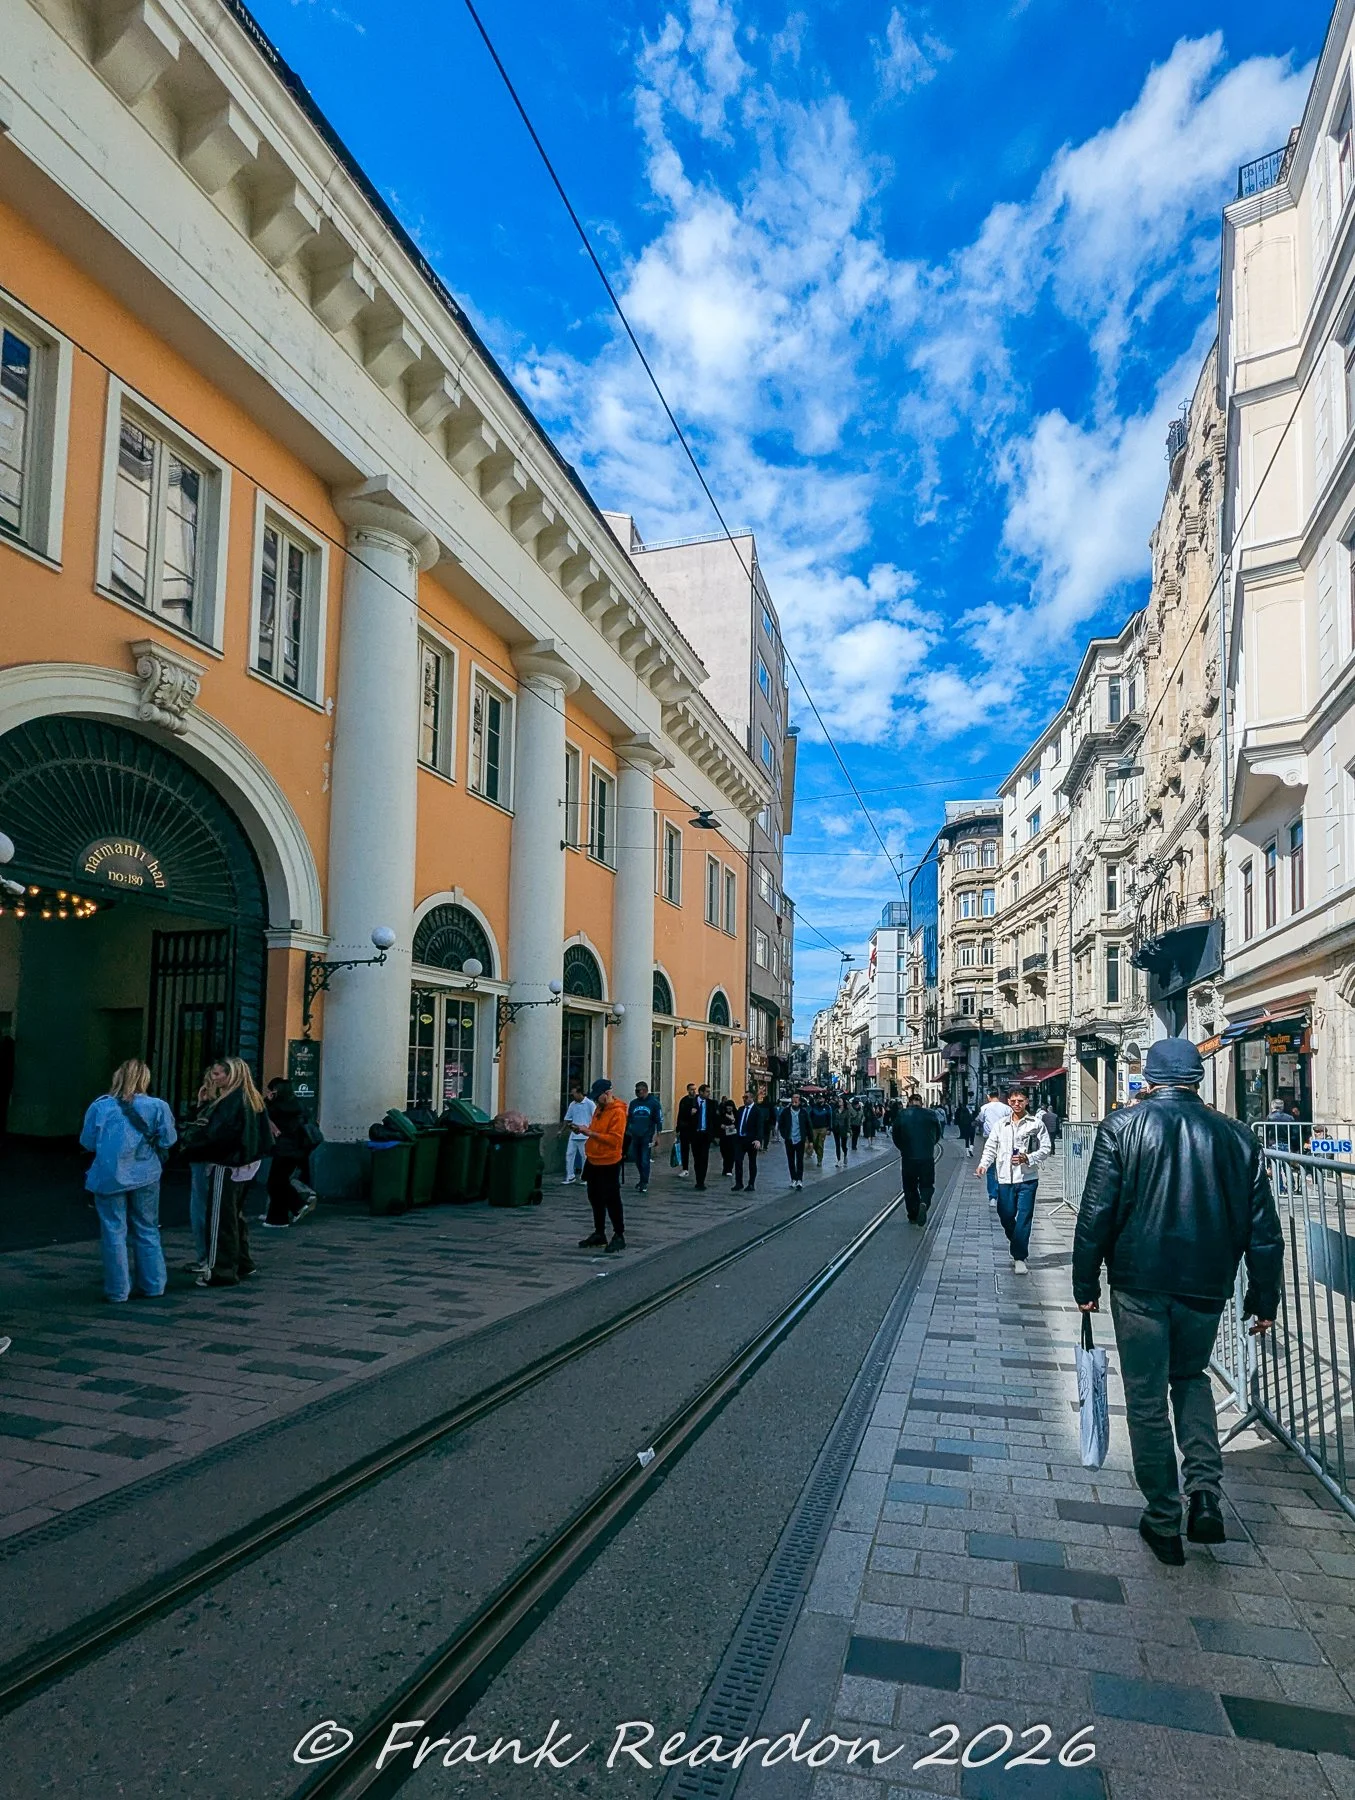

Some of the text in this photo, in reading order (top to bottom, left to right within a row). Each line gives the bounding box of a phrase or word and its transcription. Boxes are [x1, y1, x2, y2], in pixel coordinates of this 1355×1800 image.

[84, 843, 165, 888] narmanlı han
[108, 870, 144, 886] no:180
[1311, 1140, 1352, 1153] POLIS
